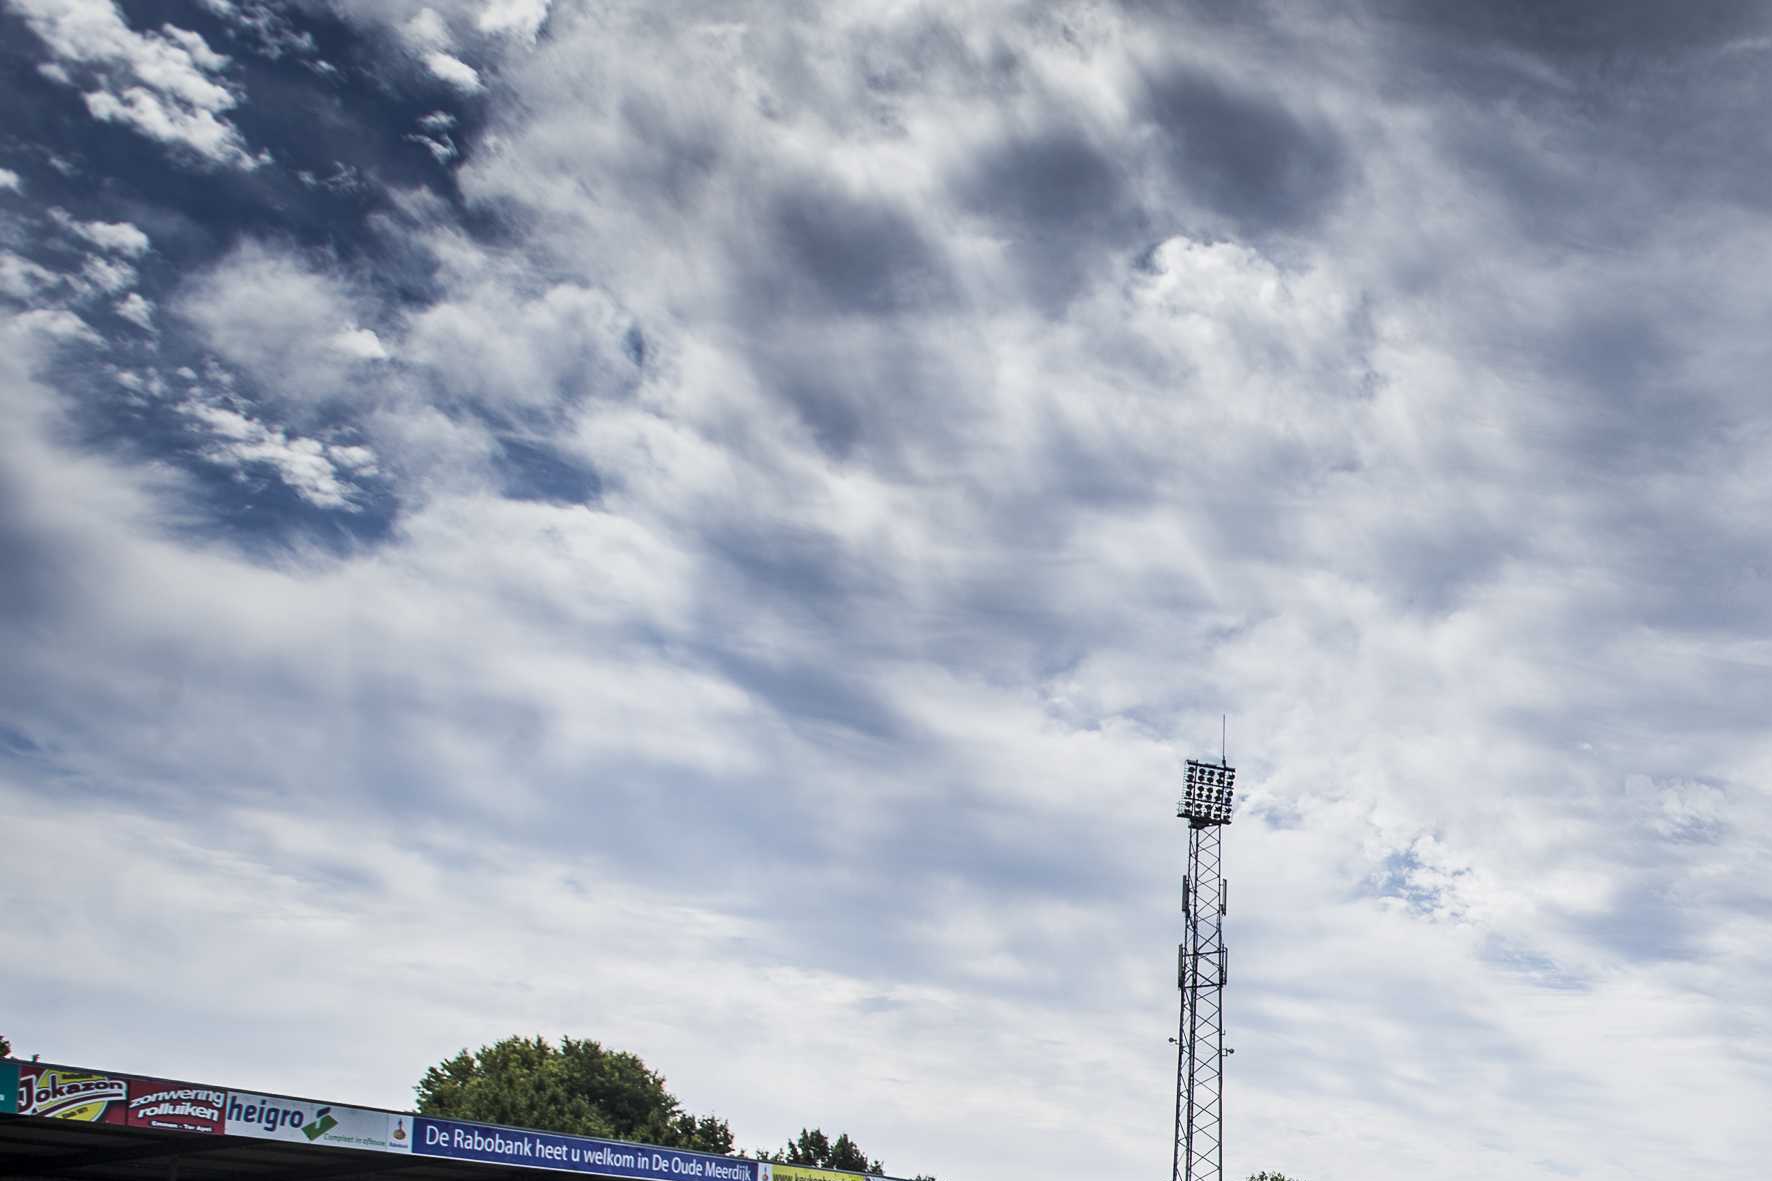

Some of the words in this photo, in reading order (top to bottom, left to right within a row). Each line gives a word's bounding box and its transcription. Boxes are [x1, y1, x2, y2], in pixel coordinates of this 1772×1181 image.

[19, 1074, 126, 1114] Jokazon
[130, 1088, 224, 1108] zonwering
[138, 1102, 219, 1121] rolluiken
[228, 1096, 304, 1131] heigro
[426, 1126, 449, 1146] De
[454, 1129, 532, 1156] Rabobank
[536, 1138, 567, 1161] heet
[571, 1150, 580, 1162] u
[583, 1148, 634, 1168] welkom
[638, 1153, 649, 1170] in
[653, 1155, 669, 1172] De
[671, 1157, 703, 1176] Oude
